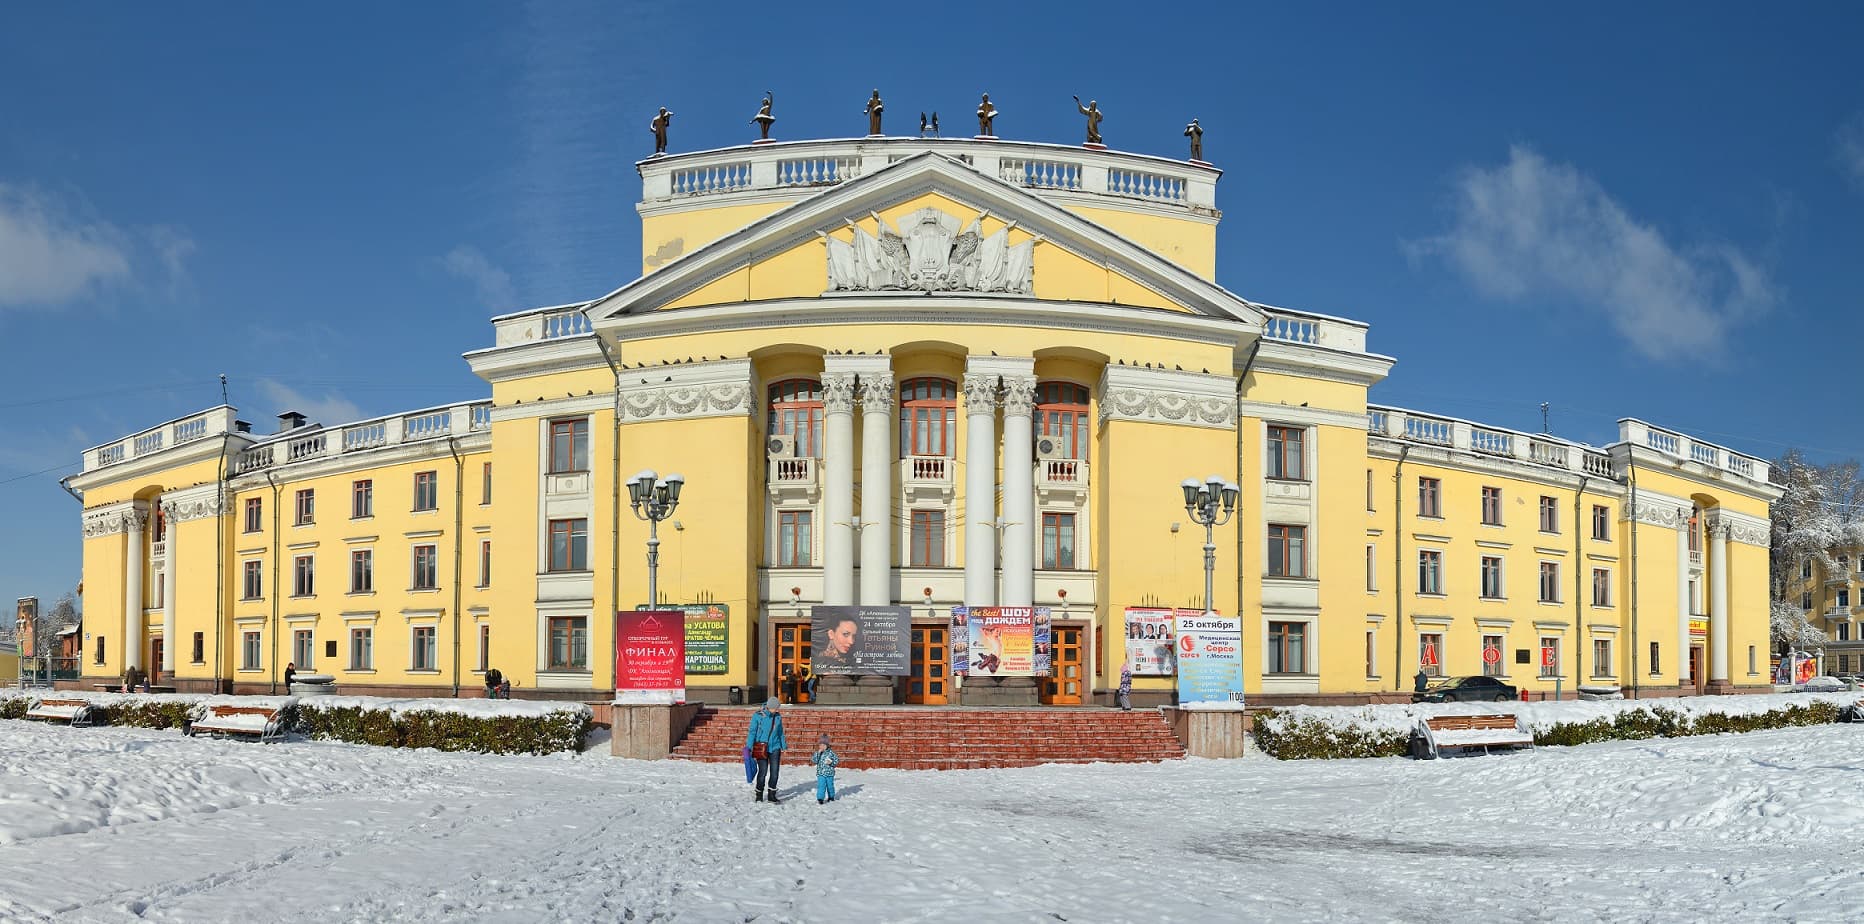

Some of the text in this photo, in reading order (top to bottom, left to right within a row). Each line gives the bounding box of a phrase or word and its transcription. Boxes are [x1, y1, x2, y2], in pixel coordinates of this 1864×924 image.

[982, 608, 999, 616] Best!
[1001, 608, 1030, 616] ШОУ
[1196, 621, 1234, 630] октября
[625, 648, 676, 656] ФИНАЛ
[1420, 643, 1556, 666] А Ф Е
